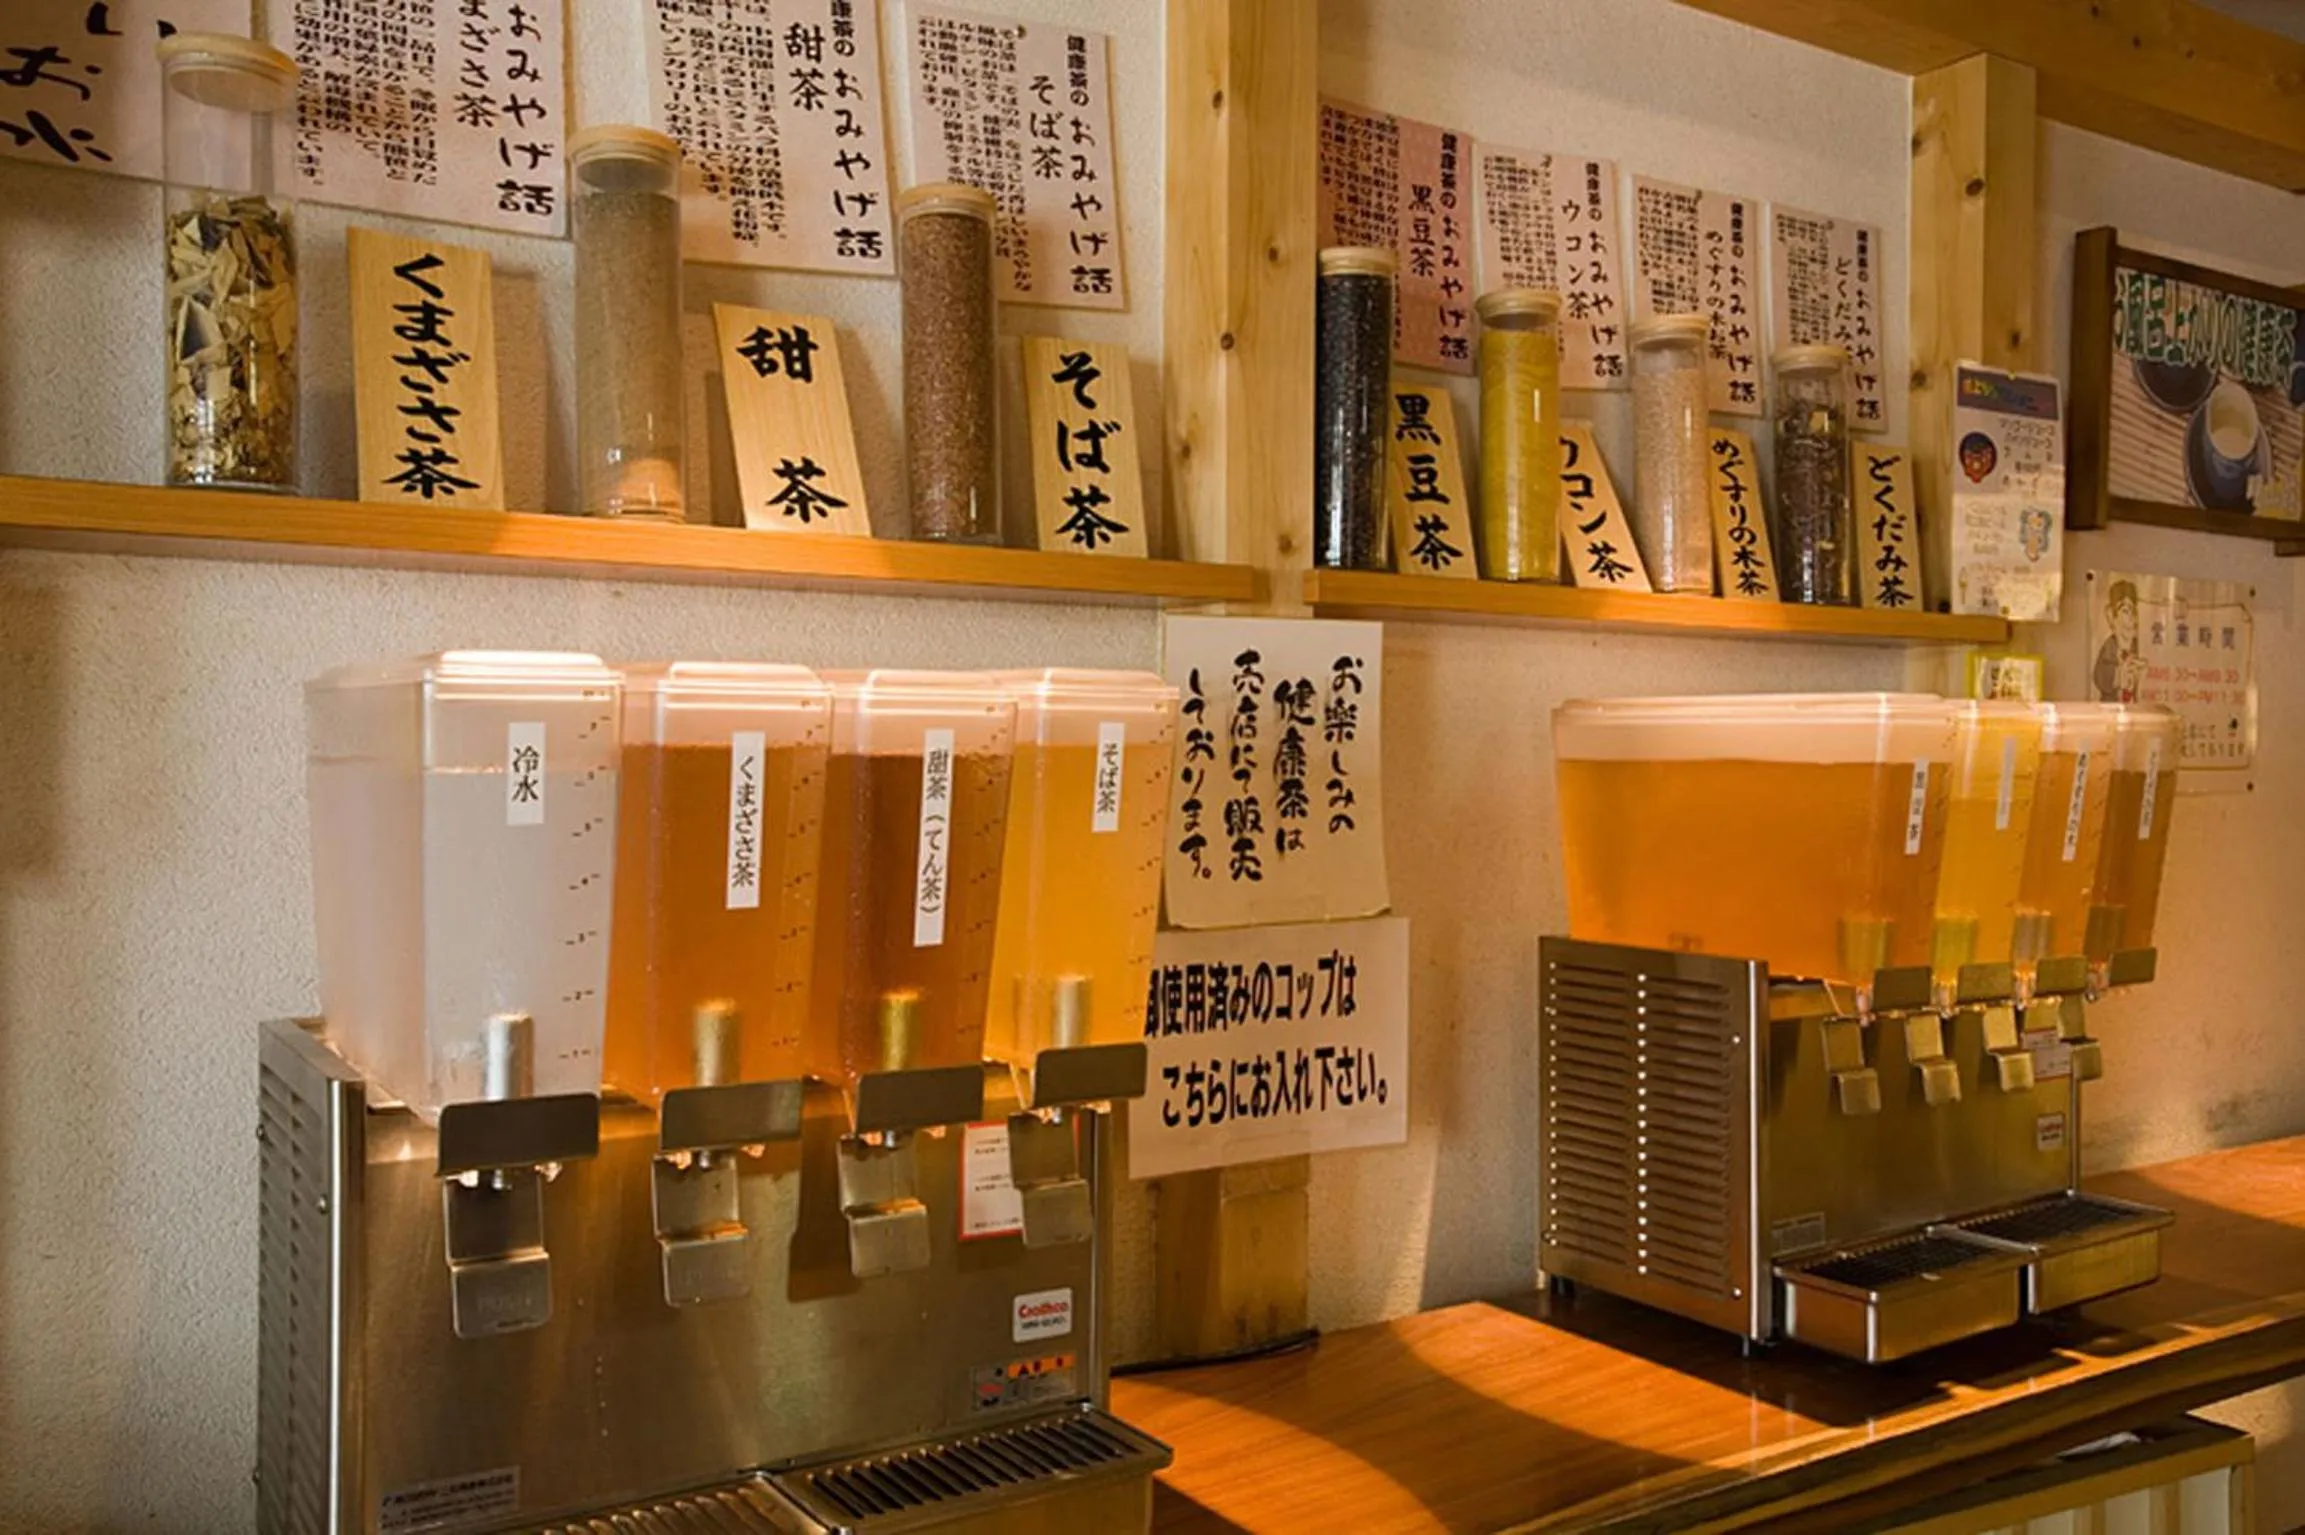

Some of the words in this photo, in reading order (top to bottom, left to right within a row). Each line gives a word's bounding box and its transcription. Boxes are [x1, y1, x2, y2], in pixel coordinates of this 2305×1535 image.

[783, 22, 828, 111] 甜茶
[1029, 75, 1064, 180] そば茶
[1408, 184, 1436, 277] 黒豆茶
[1561, 199, 1591, 320] ウコン茶
[381, 253, 481, 499] くまざさ茶
[737, 324, 848, 523] 甜茶
[1051, 352, 1129, 549] そば茶
[1395, 393, 1464, 571] 黒豆茶
[1867, 455, 1914, 608] どくだみ茶
[511, 745, 540, 803] 冷水
[731, 755, 759, 888] くまざさ茶
[1096, 742, 1119, 814] そば茶
[1178, 667, 1216, 879] しております。
[1223, 649, 1265, 882] 売店にて販売
[1273, 677, 1316, 857] 健康茶は
[1324, 656, 1364, 834] お楽しみの
[1162, 1046, 1388, 1128] こちらにお入れ下さい。
